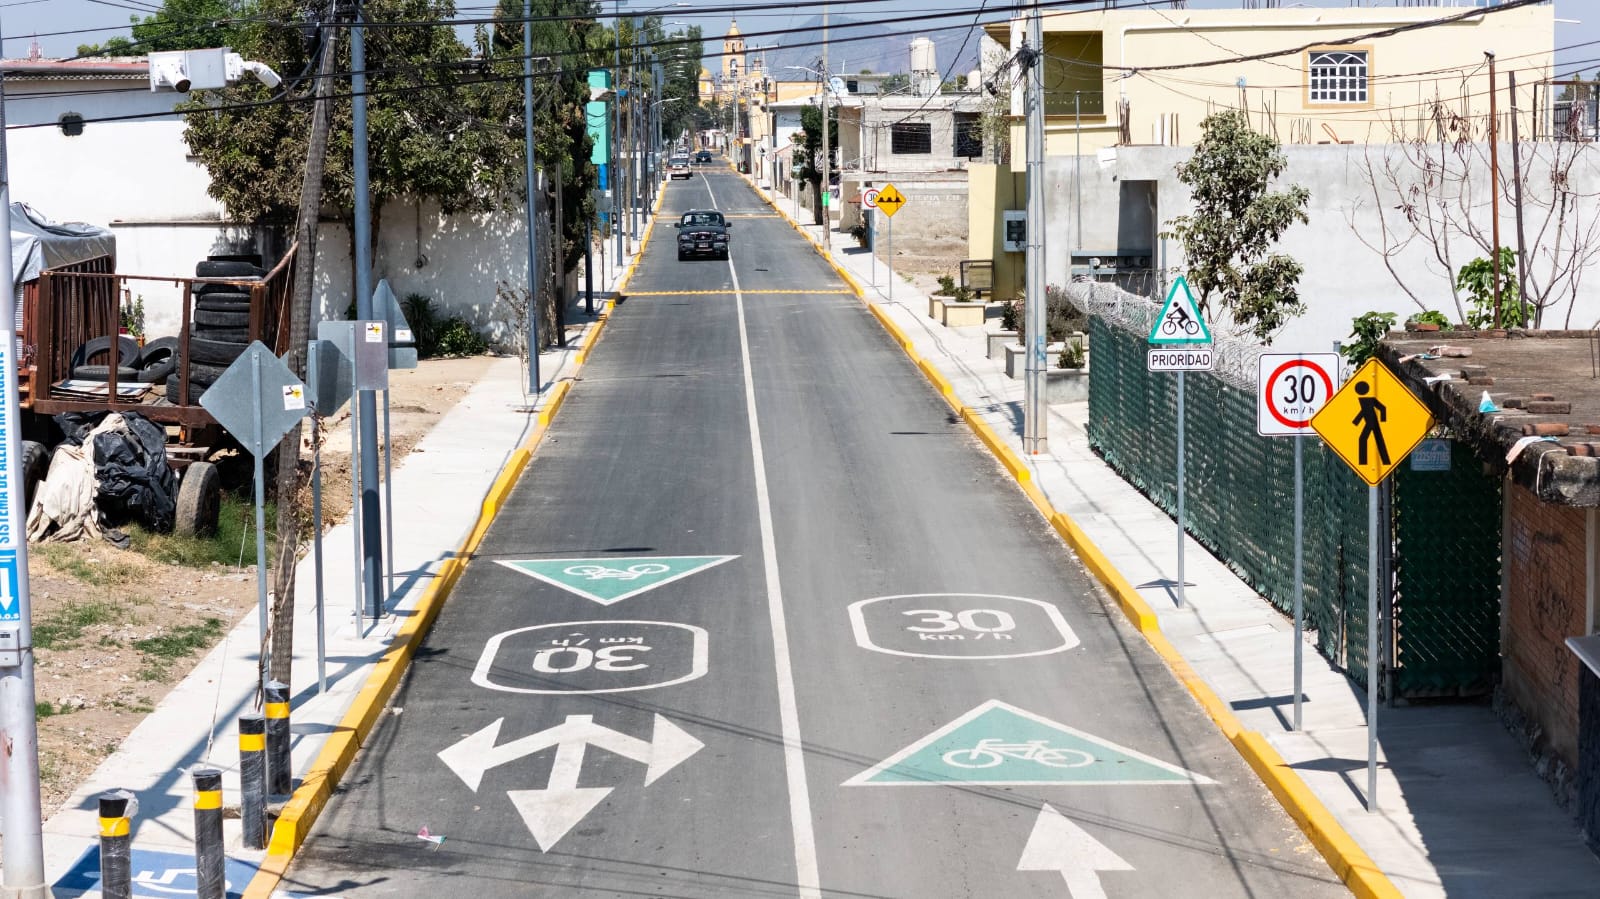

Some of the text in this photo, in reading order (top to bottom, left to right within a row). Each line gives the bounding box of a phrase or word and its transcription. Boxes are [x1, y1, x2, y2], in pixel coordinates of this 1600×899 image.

[1152, 354, 1210, 366] PRIORIDAD
[1283, 374, 1315, 404] 30
[901, 609, 1016, 633] 30
[532, 644, 653, 674] 30
